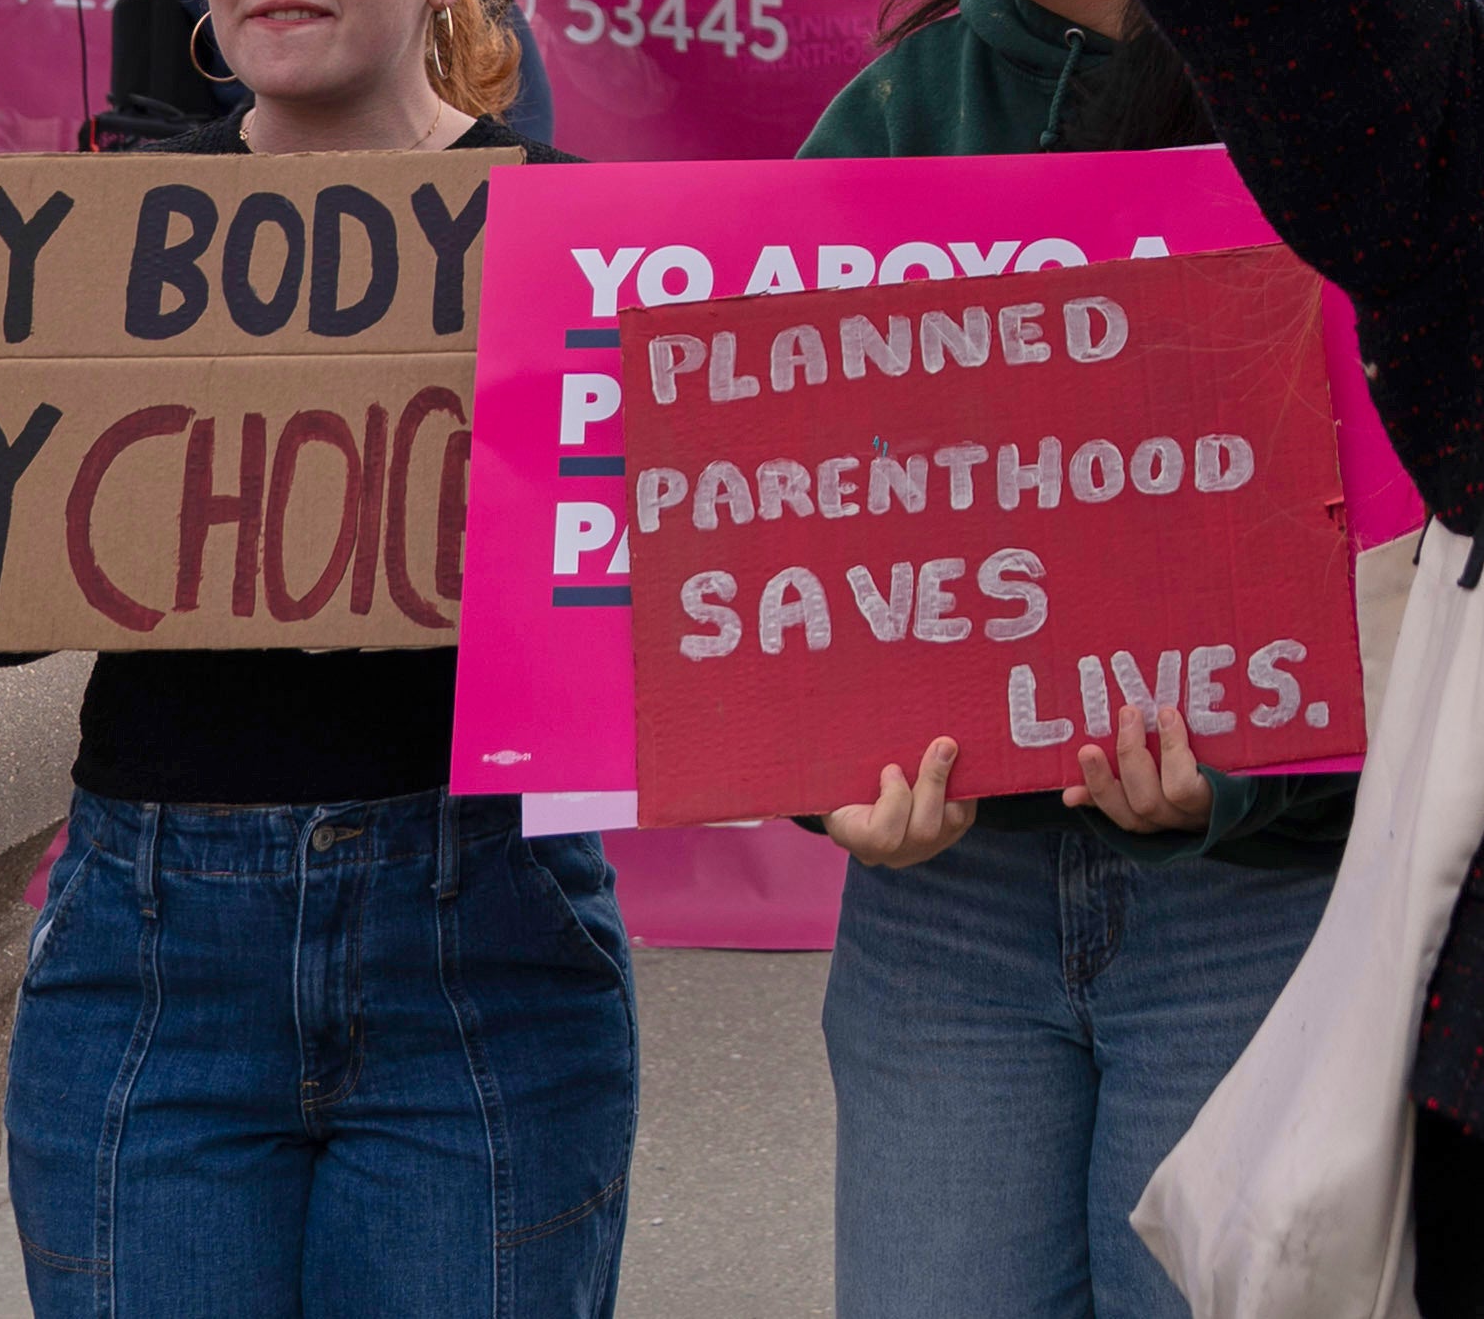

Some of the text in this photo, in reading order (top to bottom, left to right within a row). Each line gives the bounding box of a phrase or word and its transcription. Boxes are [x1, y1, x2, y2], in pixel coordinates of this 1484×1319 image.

[123, 181, 489, 340] BODY
[570, 246, 714, 319] YO
[649, 295, 1129, 405] PLANNED
[636, 434, 1255, 534] PARENTHOOD
[679, 547, 1049, 662] SAVES
[1007, 638, 1329, 748] LIVES.
